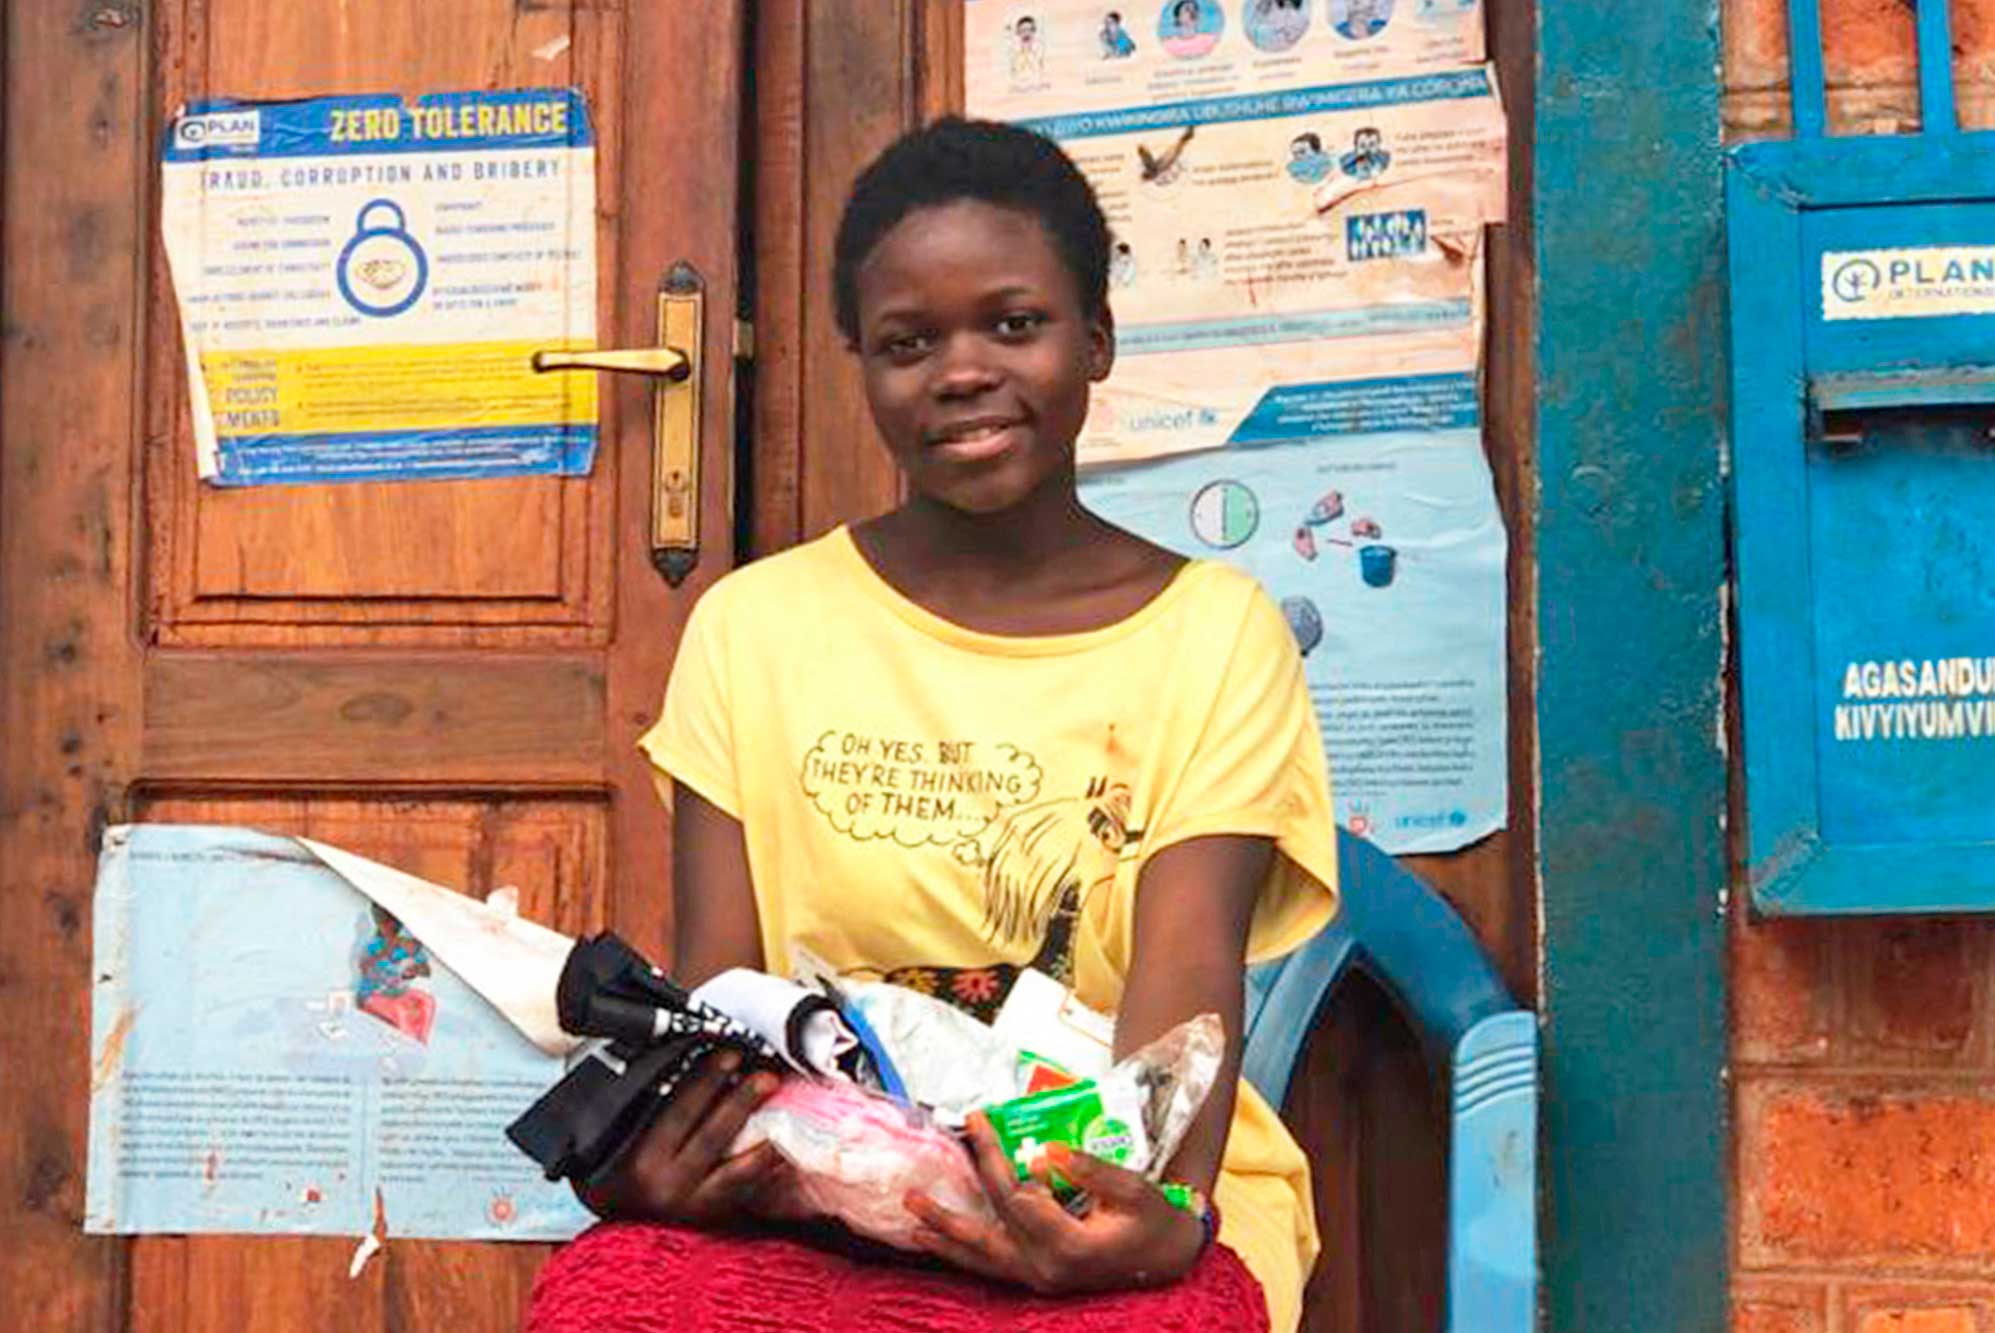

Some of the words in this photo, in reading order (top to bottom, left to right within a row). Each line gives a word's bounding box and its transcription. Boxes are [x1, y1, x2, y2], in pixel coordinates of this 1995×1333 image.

[208, 119, 255, 132] PLAN
[330, 108, 400, 143] ZERO
[412, 101, 568, 140] TOLERANCE
[281, 164, 411, 188] CORRUPTION
[423, 162, 462, 182] AND
[474, 158, 559, 181] BRIBERY
[1889, 258, 1994, 284] PLAN
[1129, 406, 1193, 432] unicef
[1843, 655, 1995, 699] AGASANDU
[841, 733, 871, 755] OH
[938, 740, 975, 765] BUT
[911, 769, 1022, 795] THINKING
[846, 792, 873, 815] OF
